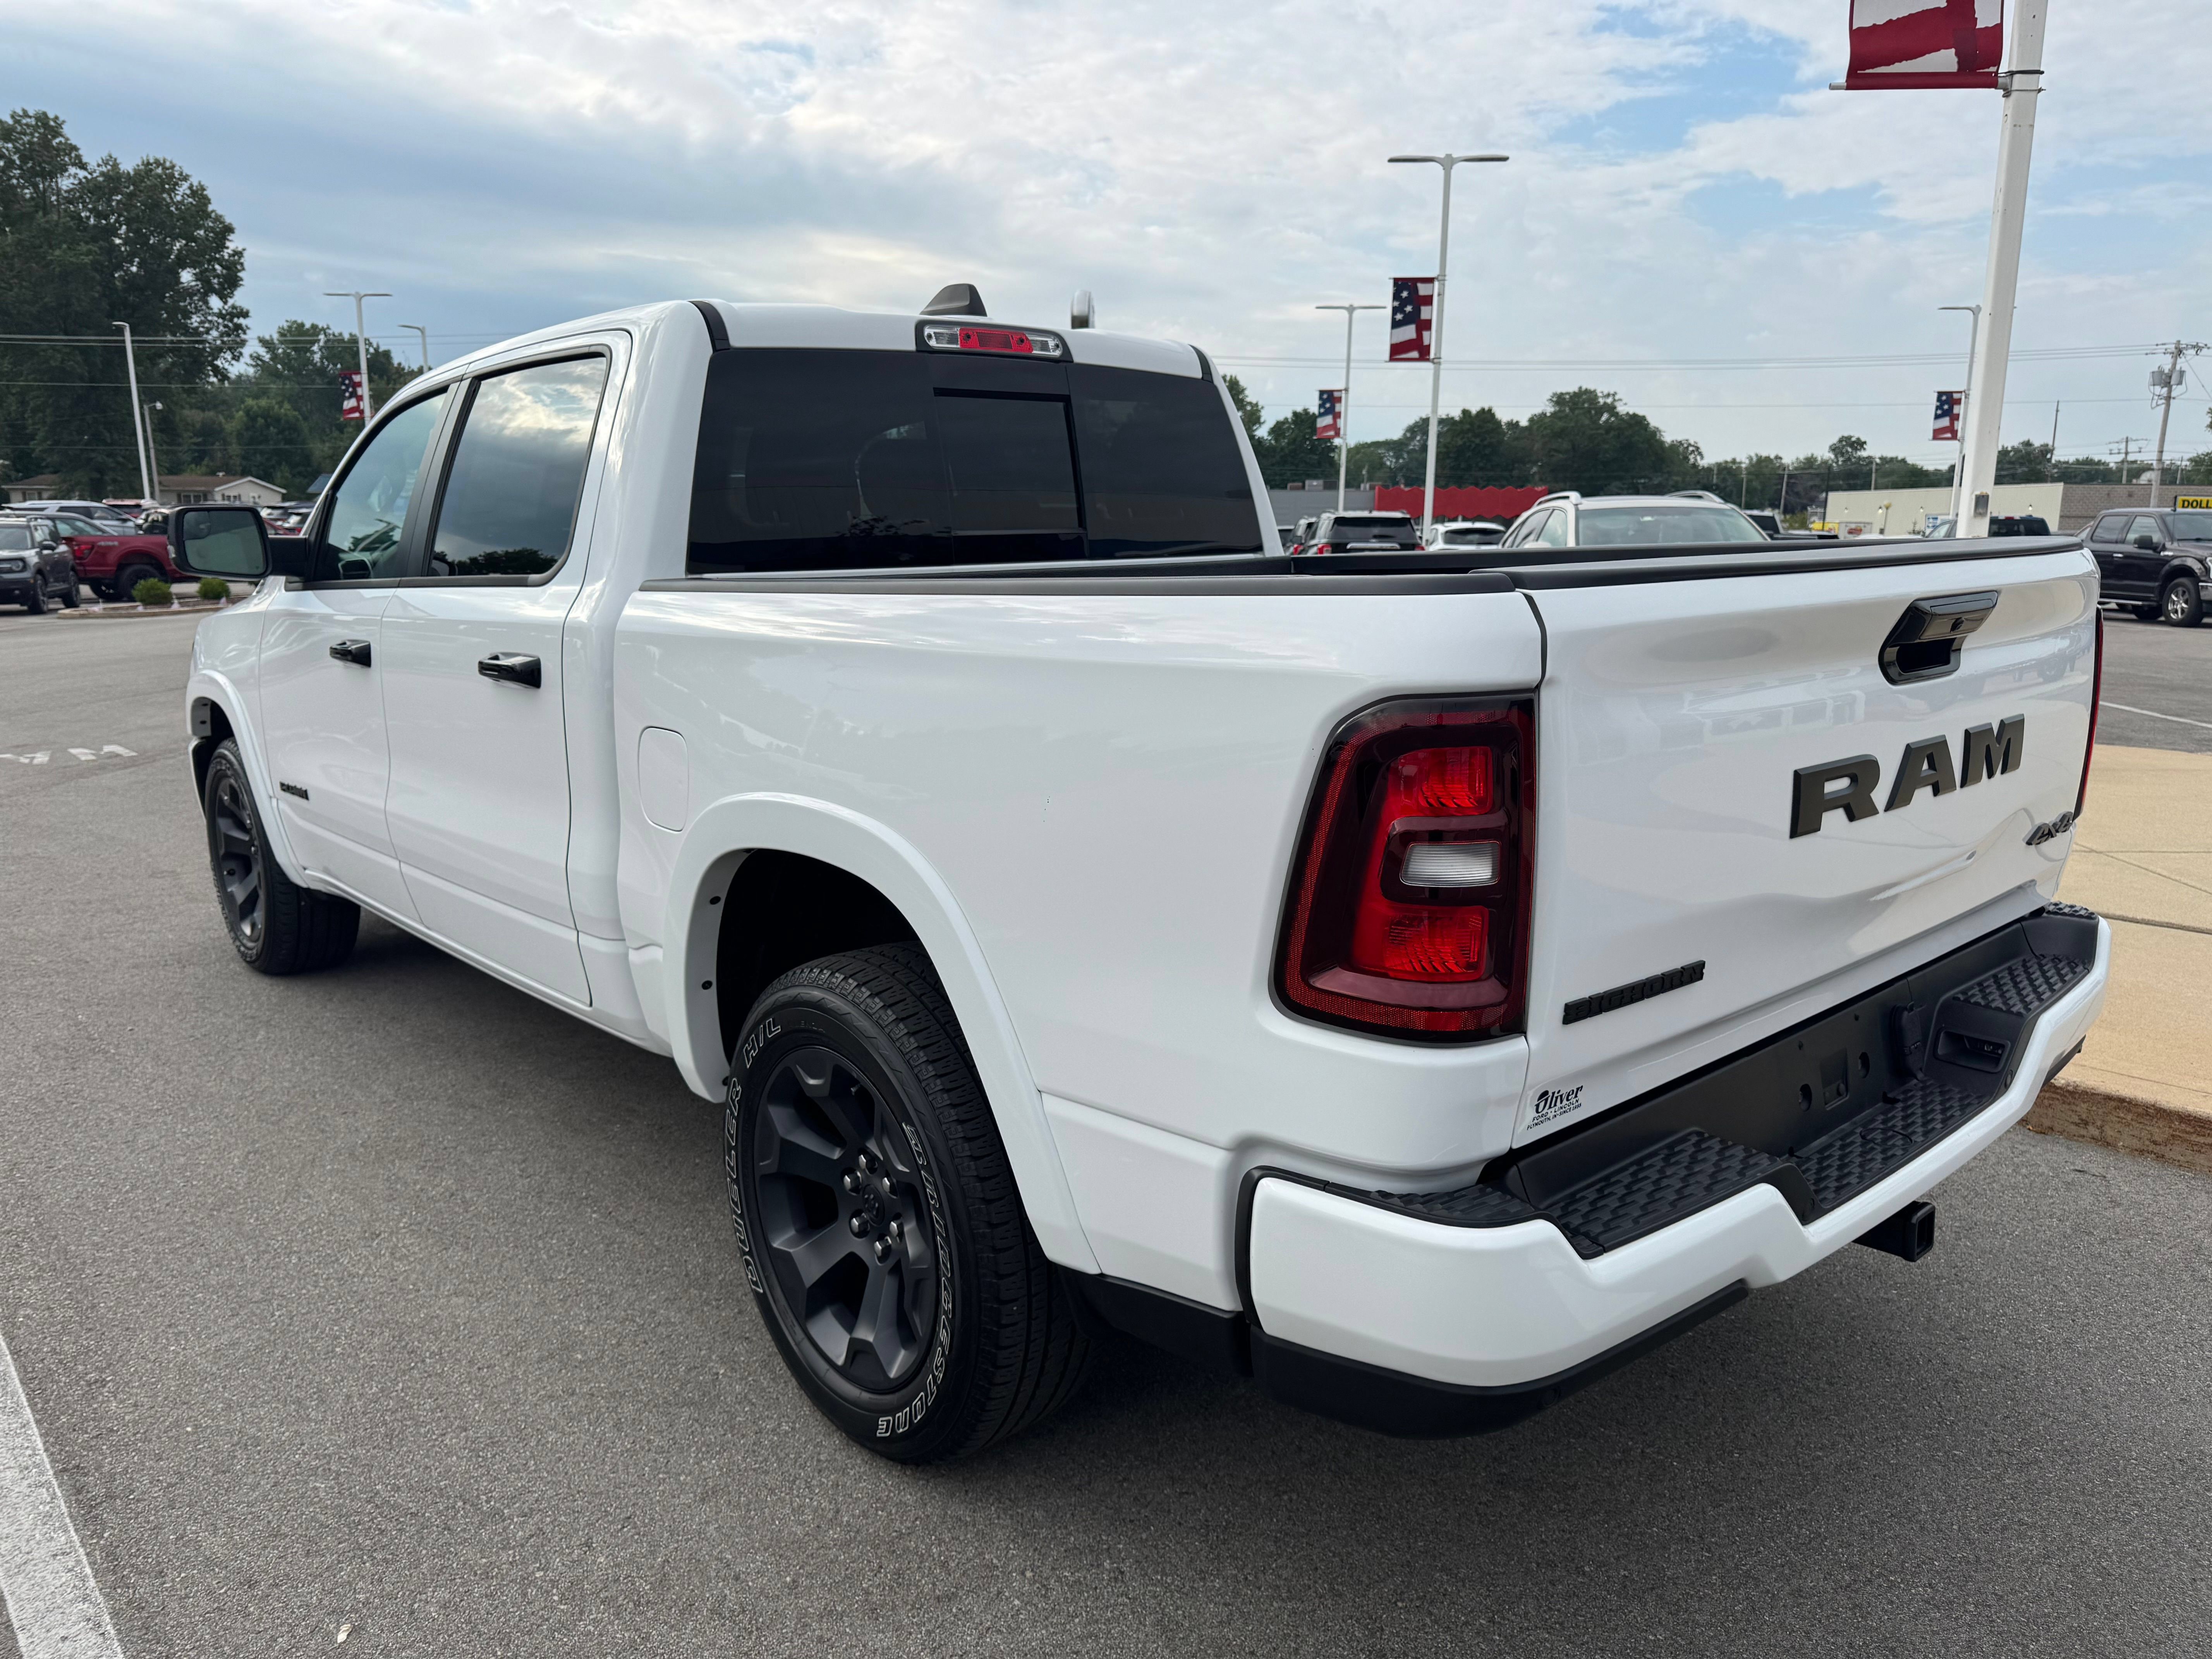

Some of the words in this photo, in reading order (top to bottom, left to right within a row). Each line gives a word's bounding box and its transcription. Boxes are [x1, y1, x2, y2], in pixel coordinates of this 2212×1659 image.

[1790, 714, 2025, 839] RAM
[743, 1017, 781, 1069] H/L
[1532, 1111, 1548, 1123] FORD
[1554, 1098, 1579, 1113] LINCOLN
[1534, 1085, 1583, 1114] Oliver
[725, 1077, 763, 1294] DUELER
[876, 1121, 953, 1437] BRIDGESTONE
